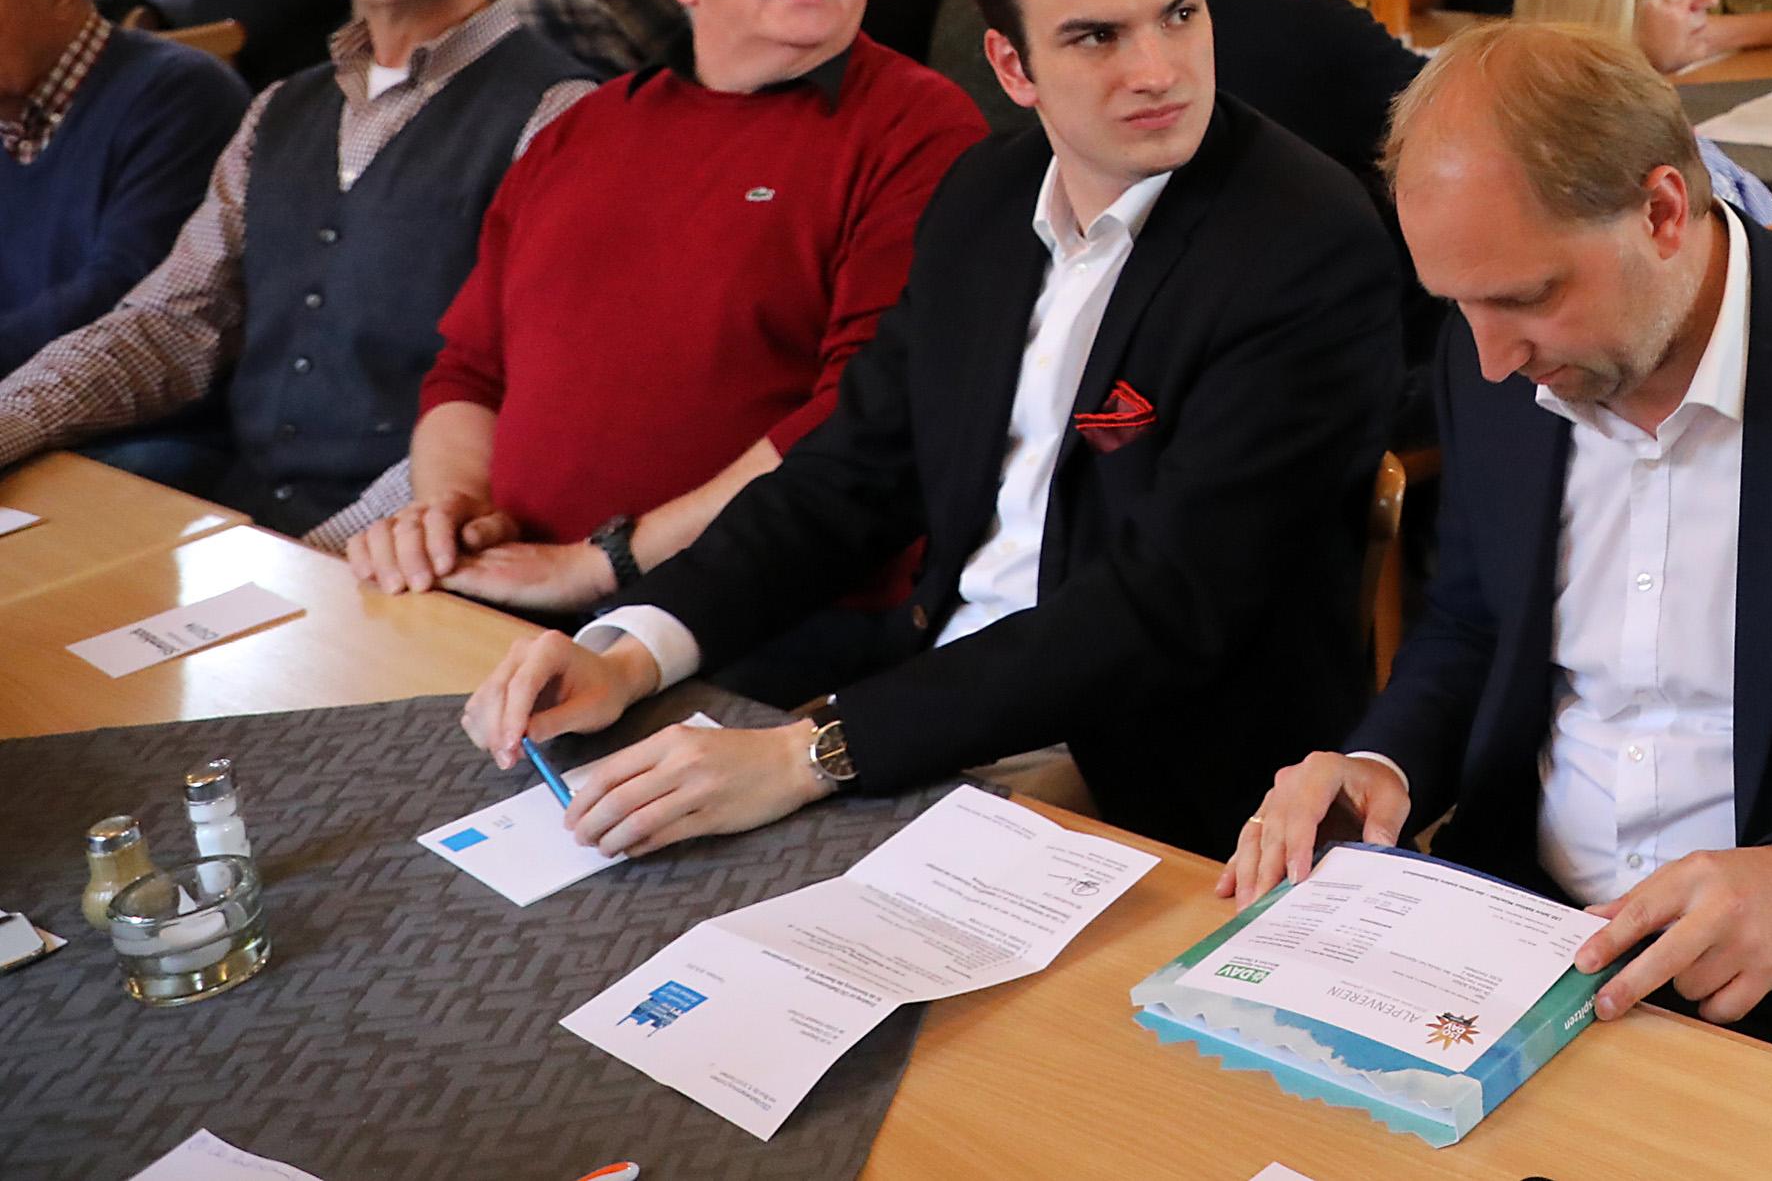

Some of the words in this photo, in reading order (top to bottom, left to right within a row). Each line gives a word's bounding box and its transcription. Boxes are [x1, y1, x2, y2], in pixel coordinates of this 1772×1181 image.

[1217, 965, 1255, 980] DAV
[1326, 985, 1422, 1023] ALPENVEREIN
[1564, 994, 1596, 1030] spitzen
[1443, 1022, 1466, 1034] DAV
